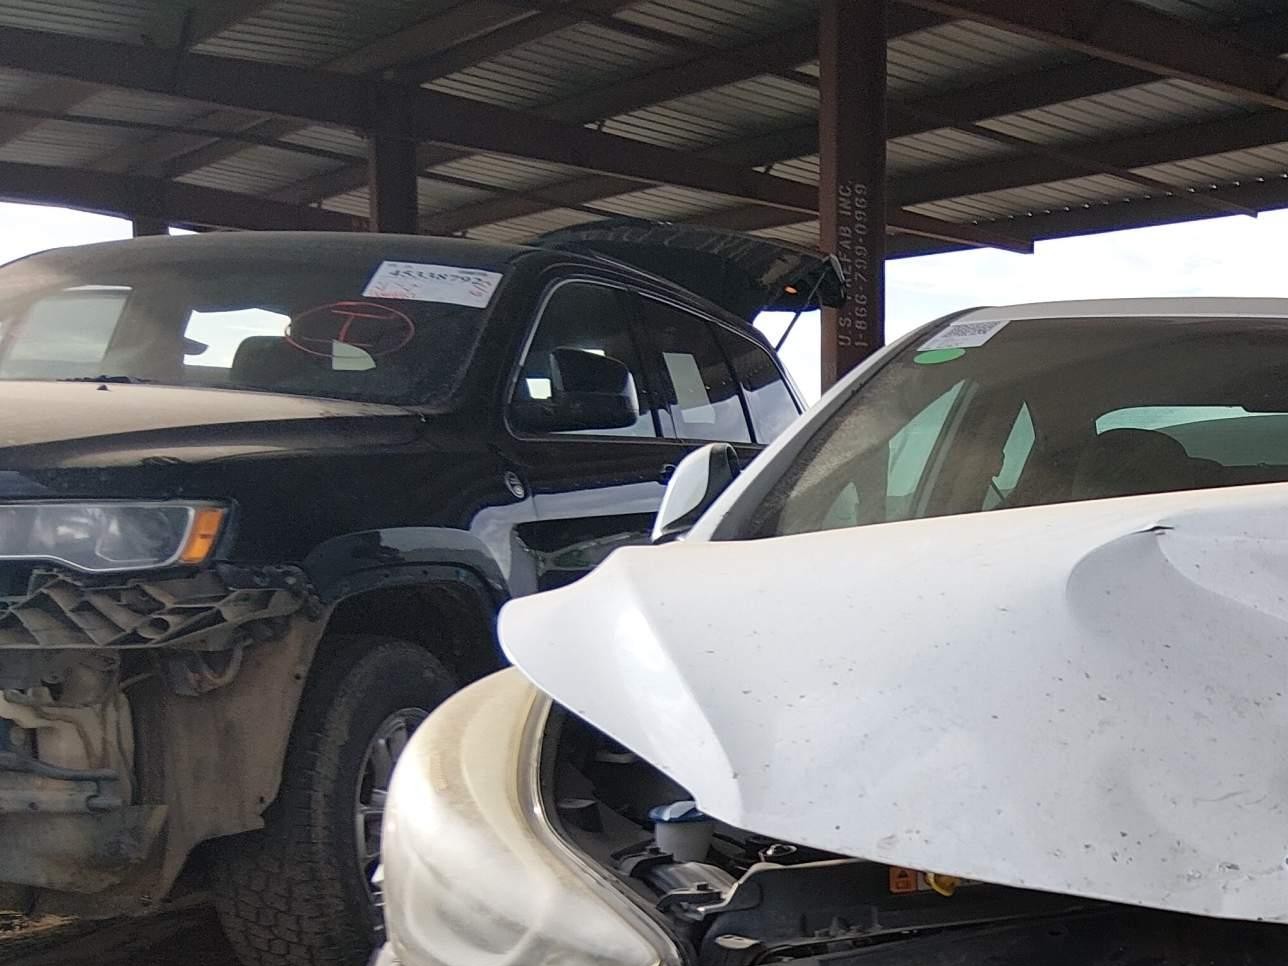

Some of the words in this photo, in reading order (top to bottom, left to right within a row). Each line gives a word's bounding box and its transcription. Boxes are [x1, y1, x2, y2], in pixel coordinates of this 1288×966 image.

[838, 181, 852, 217] INC.
[838, 225, 852, 302] EFAB
[854, 183, 868, 348] 1-866-799-0969
